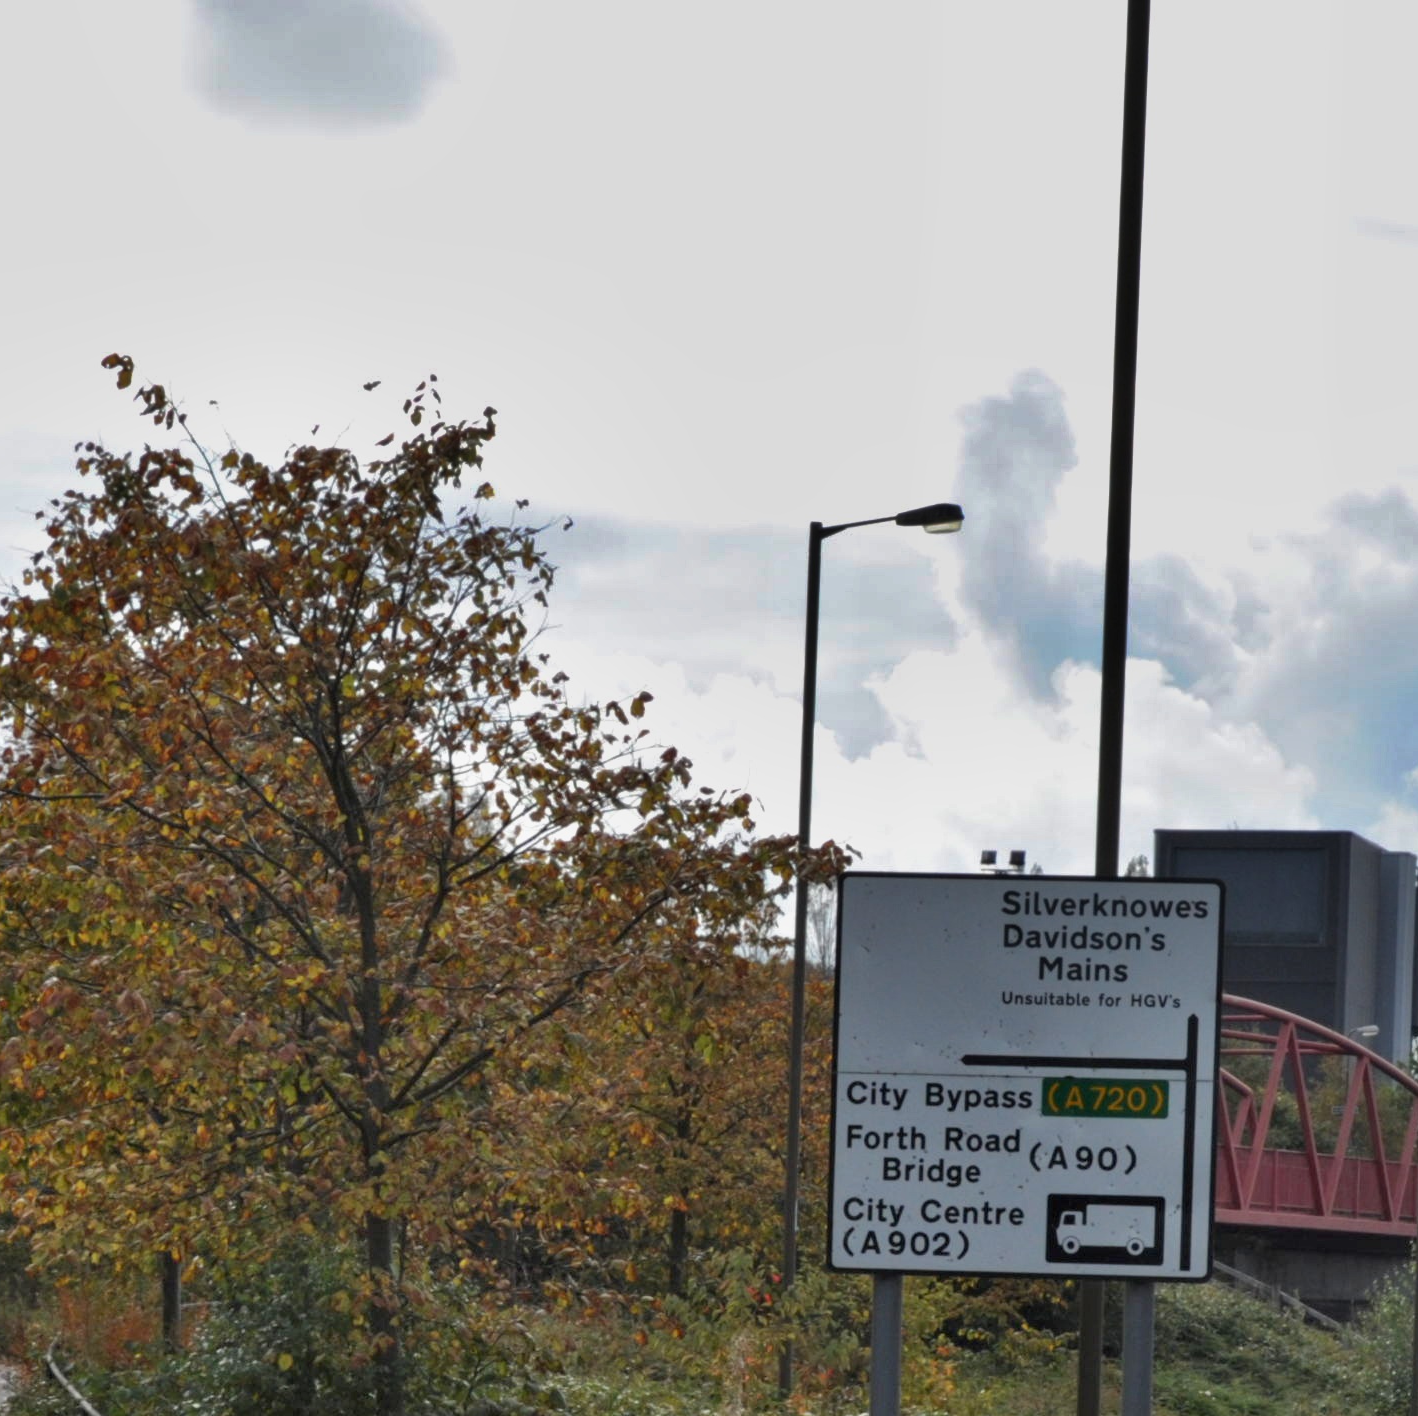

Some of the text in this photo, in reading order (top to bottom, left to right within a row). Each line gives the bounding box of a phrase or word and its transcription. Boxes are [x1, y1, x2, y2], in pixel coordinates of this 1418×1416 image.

[1001, 890, 1208, 919] Silverknowes
[1003, 924, 1166, 951] Davidson's
[1038, 957, 1128, 983] Mains
[1002, 991, 1181, 1009] Unsuitable for HGV's
[847, 1081, 1165, 1114] City Bypass (A720)
[847, 1125, 1021, 1153] Forth Road
[883, 1157, 981, 1187] Bridge
[1029, 1143, 1137, 1174] (A90)
[843, 1197, 1024, 1227] City Centre
[843, 1232, 969, 1259] (A902)
